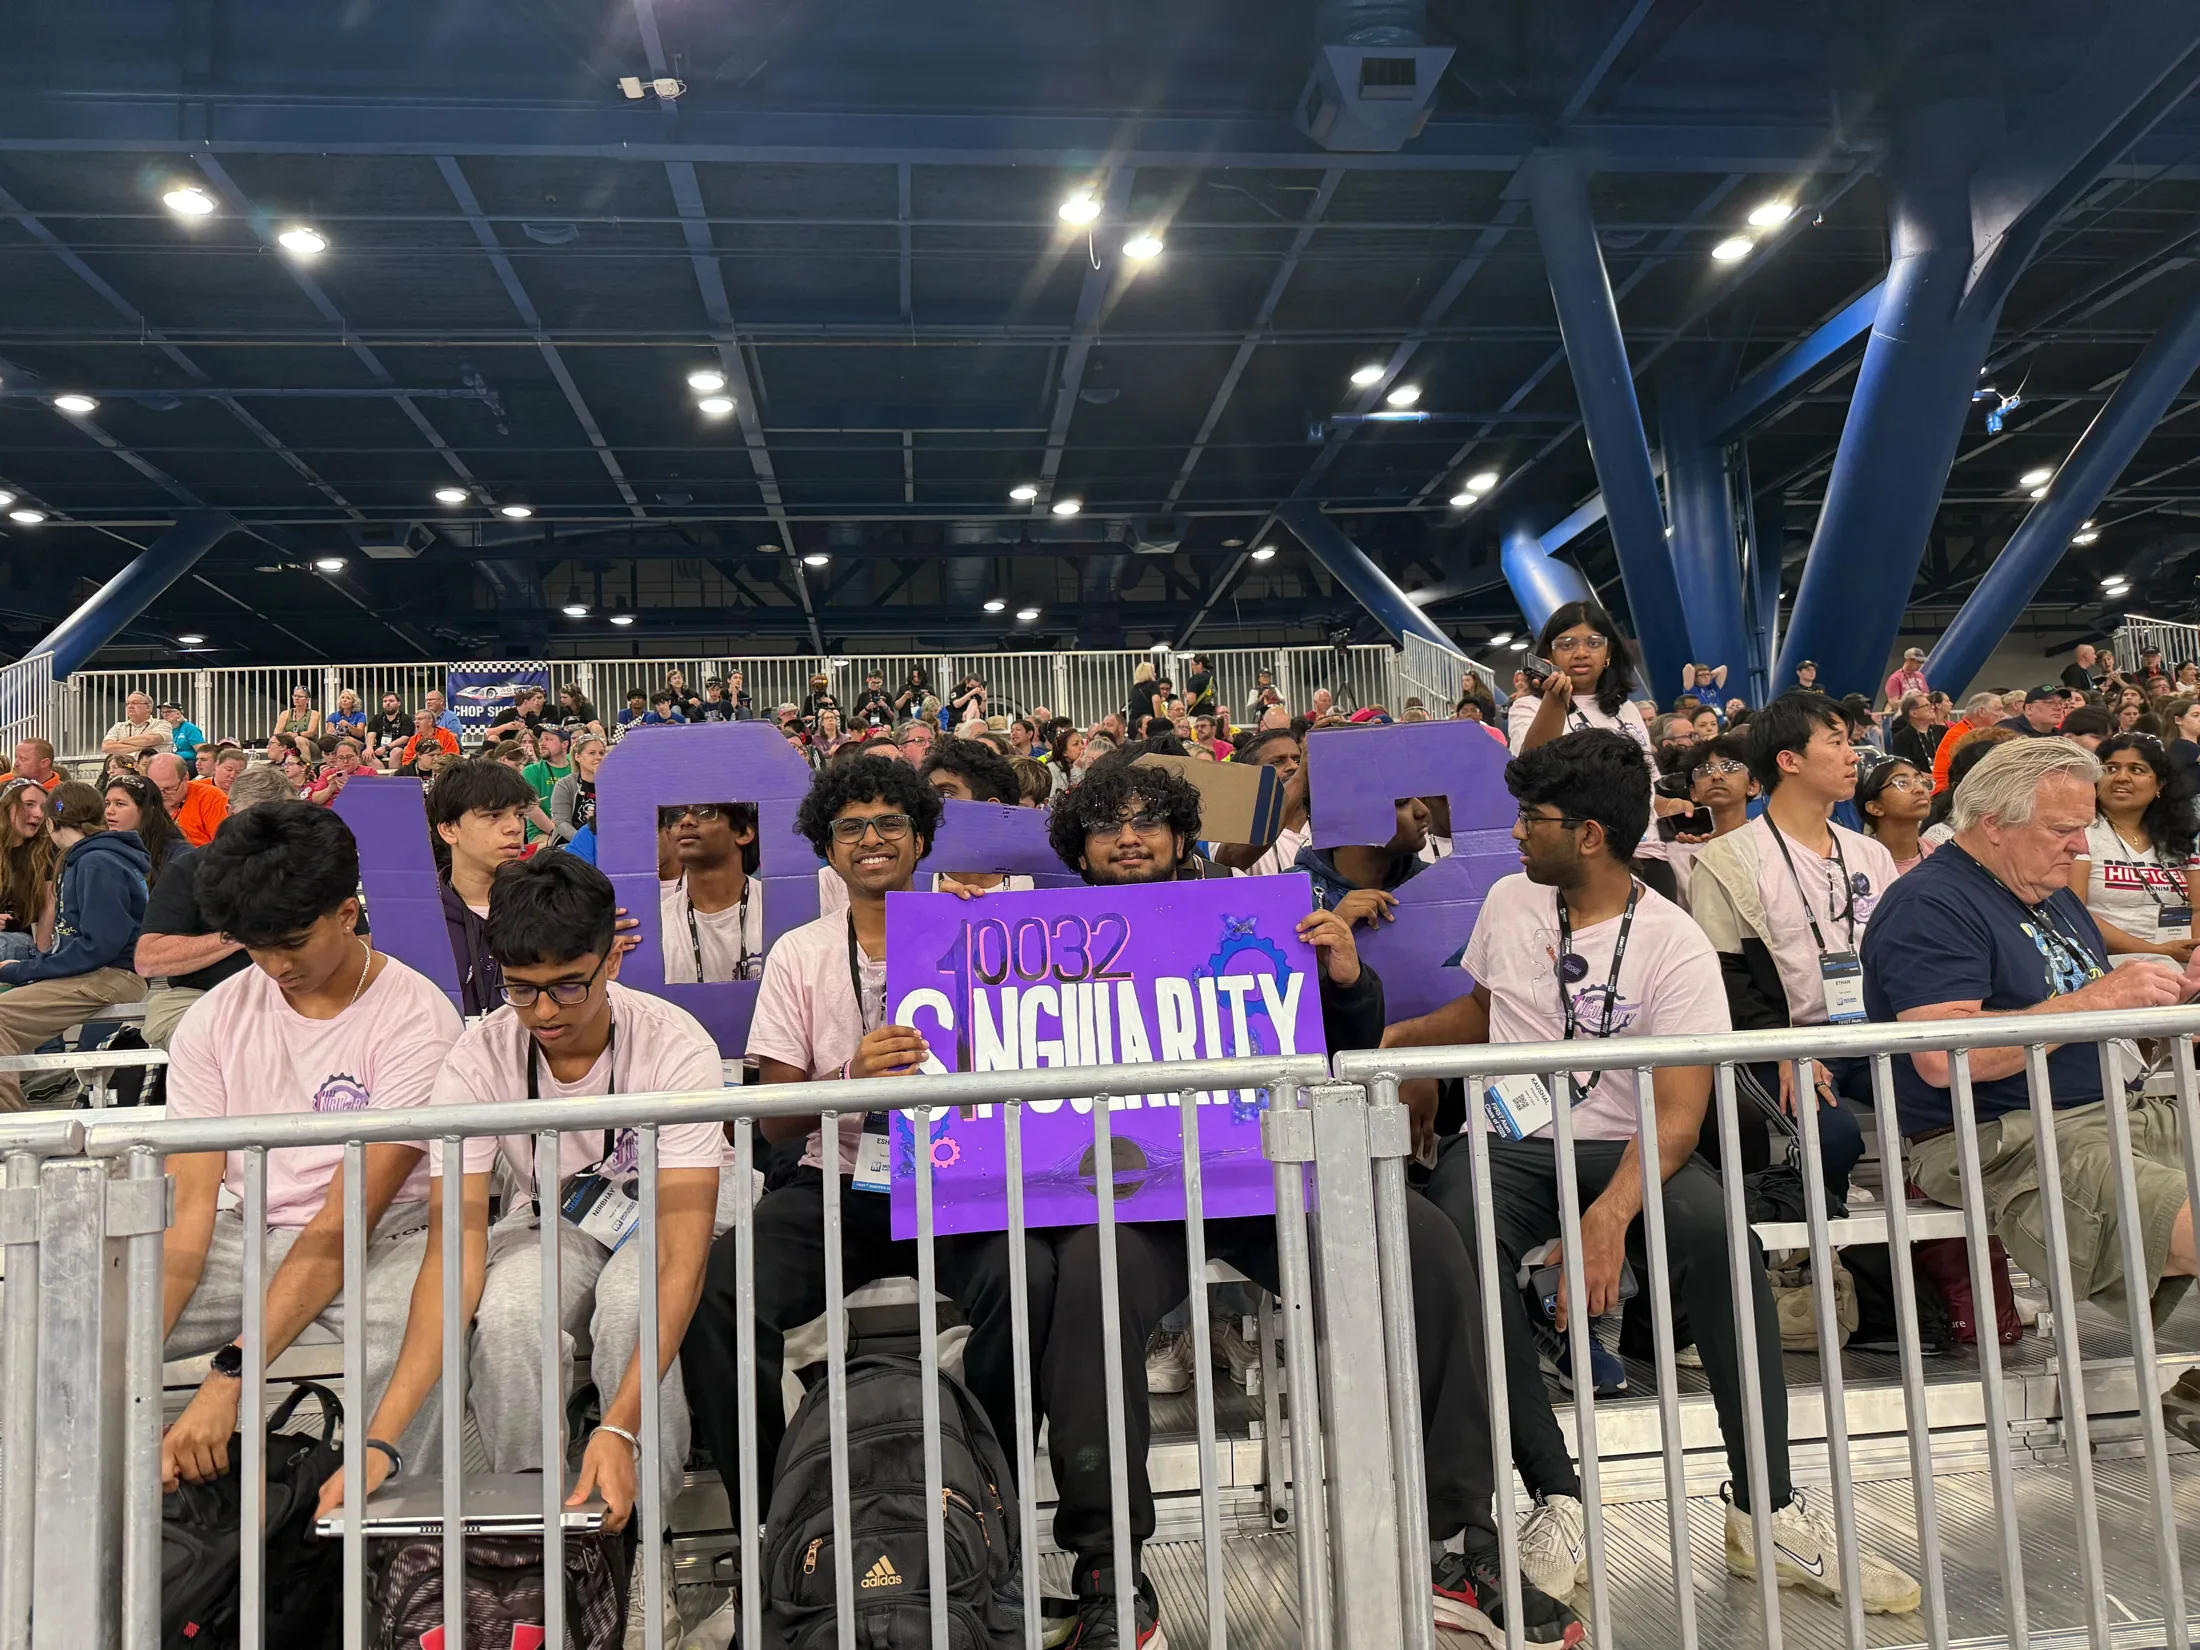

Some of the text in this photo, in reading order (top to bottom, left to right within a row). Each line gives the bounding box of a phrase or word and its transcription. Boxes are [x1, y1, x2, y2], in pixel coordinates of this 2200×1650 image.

[453, 705, 485, 717] CHOP
[936, 912, 1134, 987] 10032
[1531, 1078, 1549, 1105] KAUSHAL
[1485, 1103, 1495, 1119] Class
[1496, 1123, 1508, 1138] 2025
[592, 1187, 616, 1217] NIRBHAY
[861, 1575, 902, 1588] adidas
